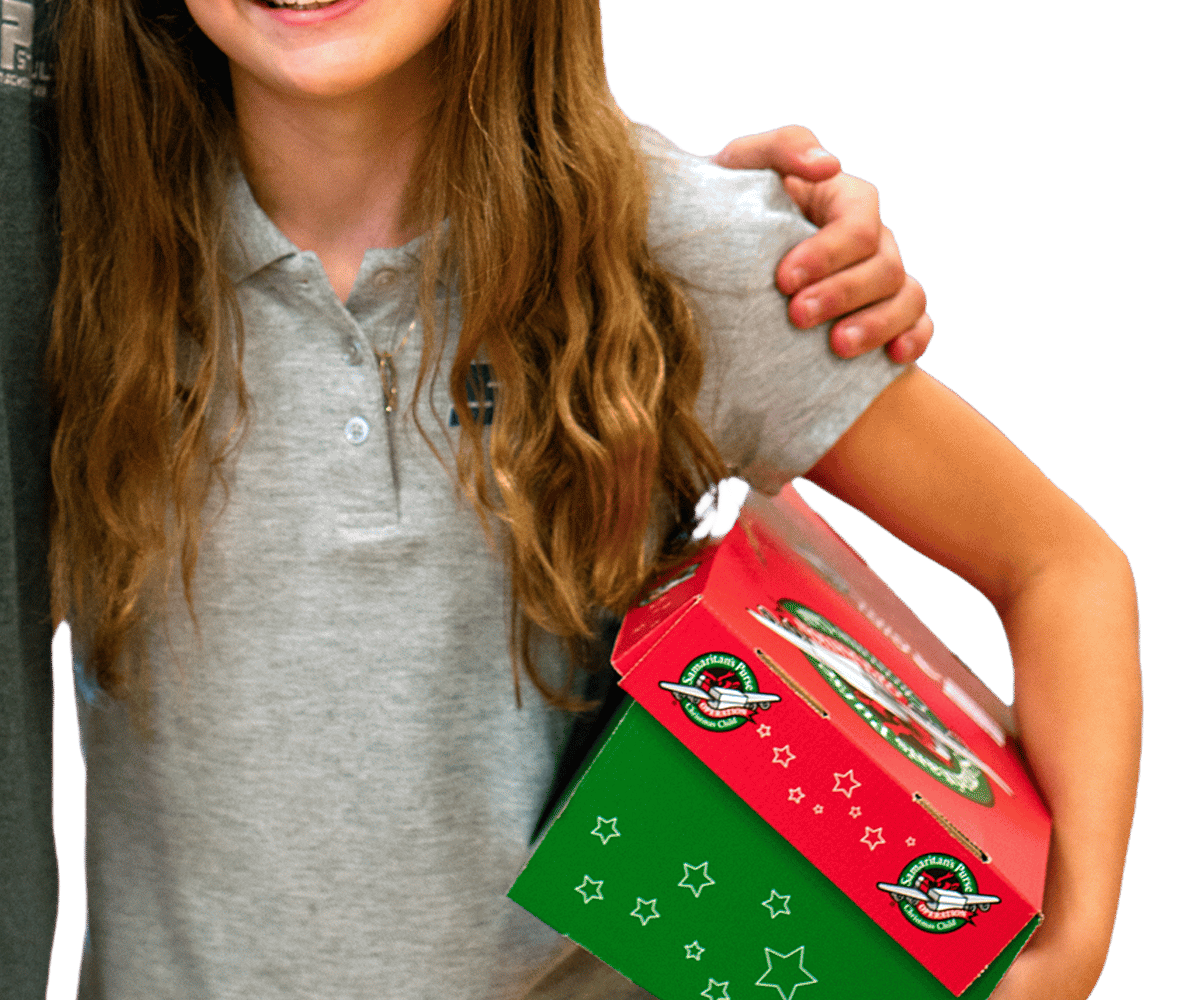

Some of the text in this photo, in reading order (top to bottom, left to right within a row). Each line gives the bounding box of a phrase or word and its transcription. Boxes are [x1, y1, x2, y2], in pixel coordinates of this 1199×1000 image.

[682, 654, 754, 692] Samaritan's Purse
[685, 702, 738, 729] Christmas Child
[900, 855, 974, 893] Samaritan's Purse
[903, 904, 957, 931] Christmas Child
